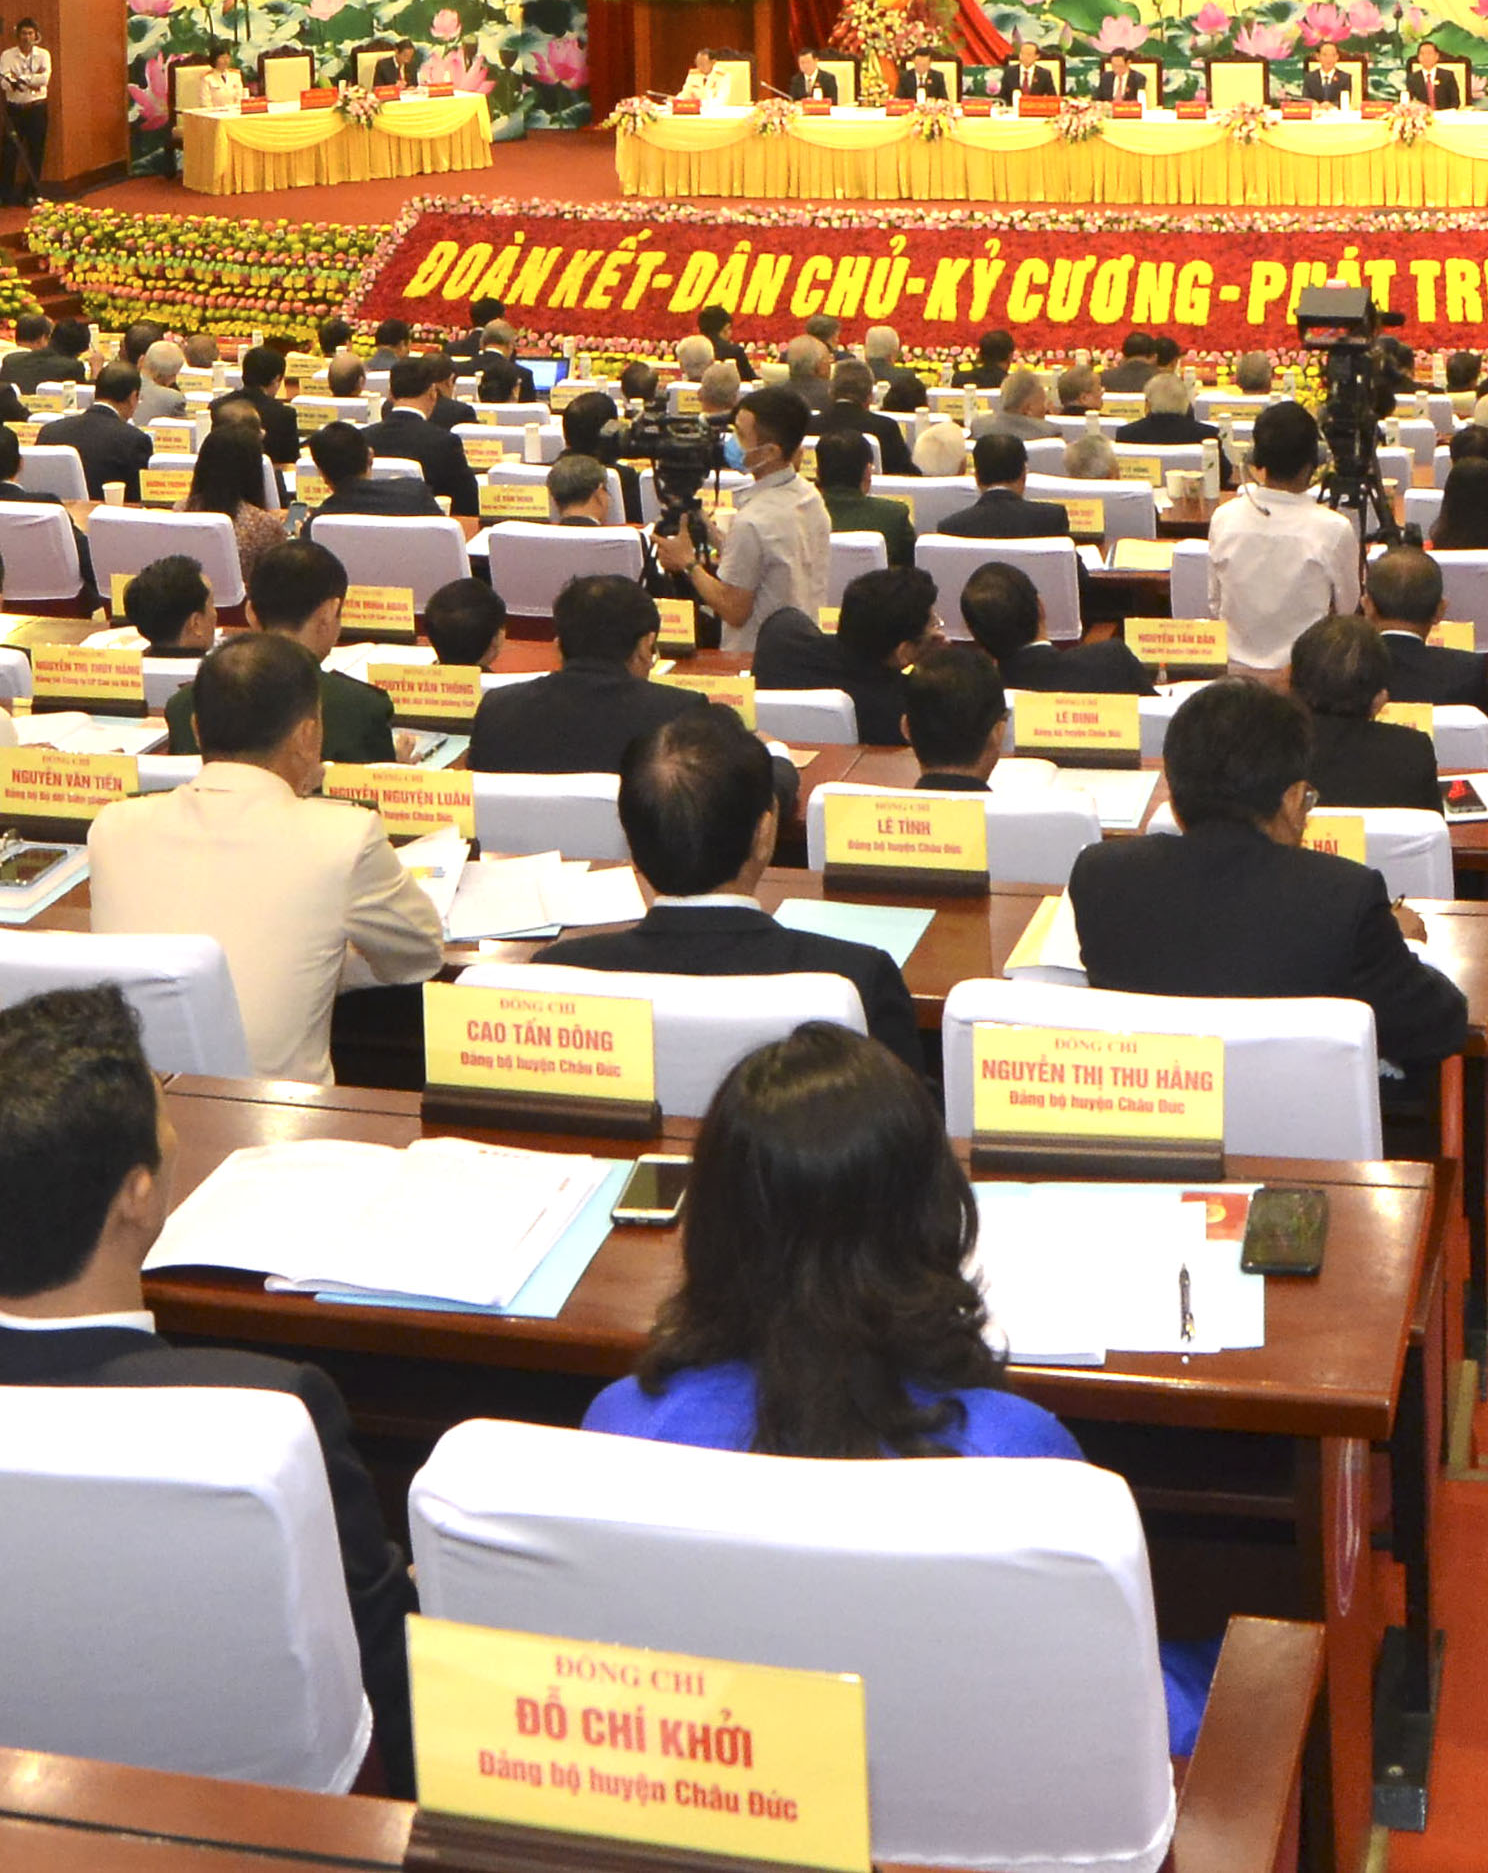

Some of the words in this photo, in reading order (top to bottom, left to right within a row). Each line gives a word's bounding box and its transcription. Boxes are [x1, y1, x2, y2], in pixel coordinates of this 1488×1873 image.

[403, 230, 562, 308] ĐOÀN
[983, 1054, 1065, 1084] NGUYỄN
[1073, 1065, 1104, 1090] THỊ
[1112, 1068, 1149, 1089] THU
[1157, 1060, 1214, 1092] HẰNG
[1011, 1092, 1046, 1109] Đảng
[1051, 1095, 1067, 1110] bộ
[1072, 1096, 1114, 1113] huyện
[1119, 1098, 1155, 1113] Châu
[1159, 1100, 1185, 1115] Đức
[517, 1687, 568, 1741] ĐỖ
[583, 1708, 647, 1753] CHÍ
[661, 1708, 754, 1770] KHỞI
[480, 1752, 543, 1788] Đảng
[552, 1763, 581, 1796] bộ
[591, 1769, 667, 1807] huyện
[675, 1780, 741, 1815] Châu
[748, 1791, 799, 1823] Đức
